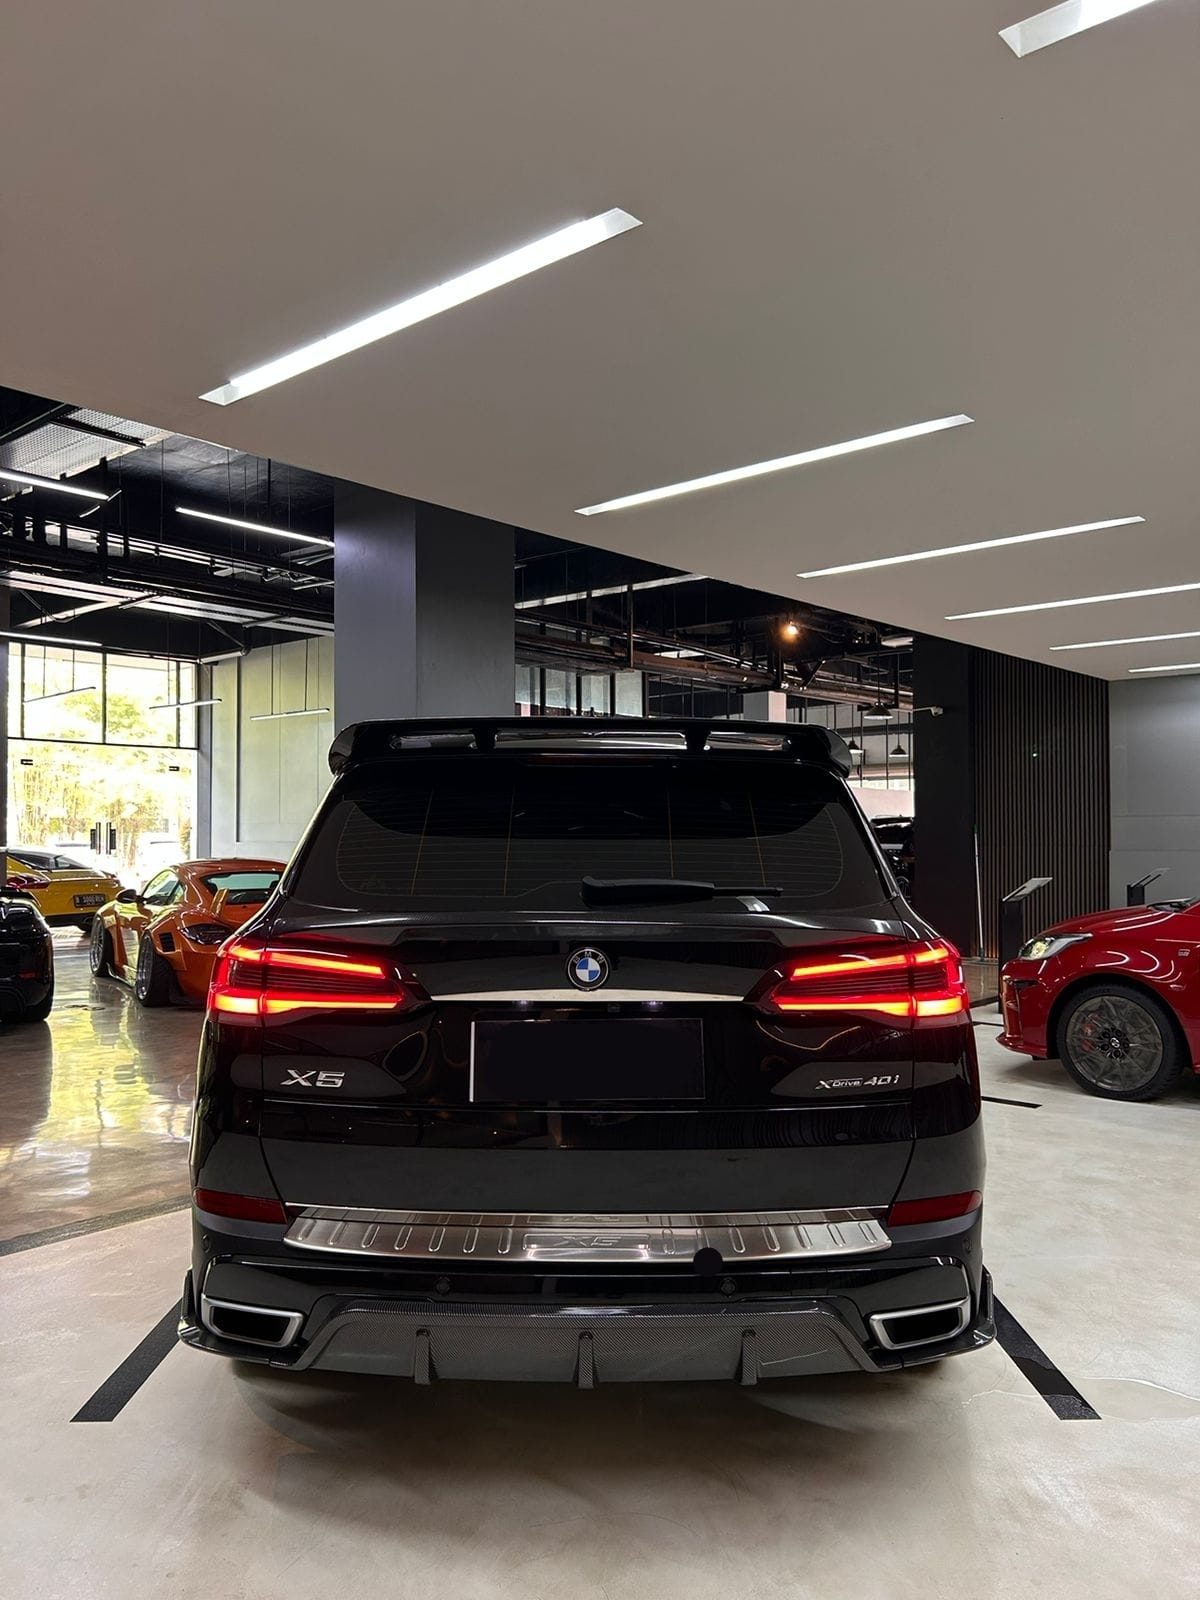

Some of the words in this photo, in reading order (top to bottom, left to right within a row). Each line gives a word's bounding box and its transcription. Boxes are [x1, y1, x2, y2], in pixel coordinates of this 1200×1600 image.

[572, 951, 605, 964] BMW
[280, 1069, 345, 1088] X5
[553, 1235, 622, 1247] X5
